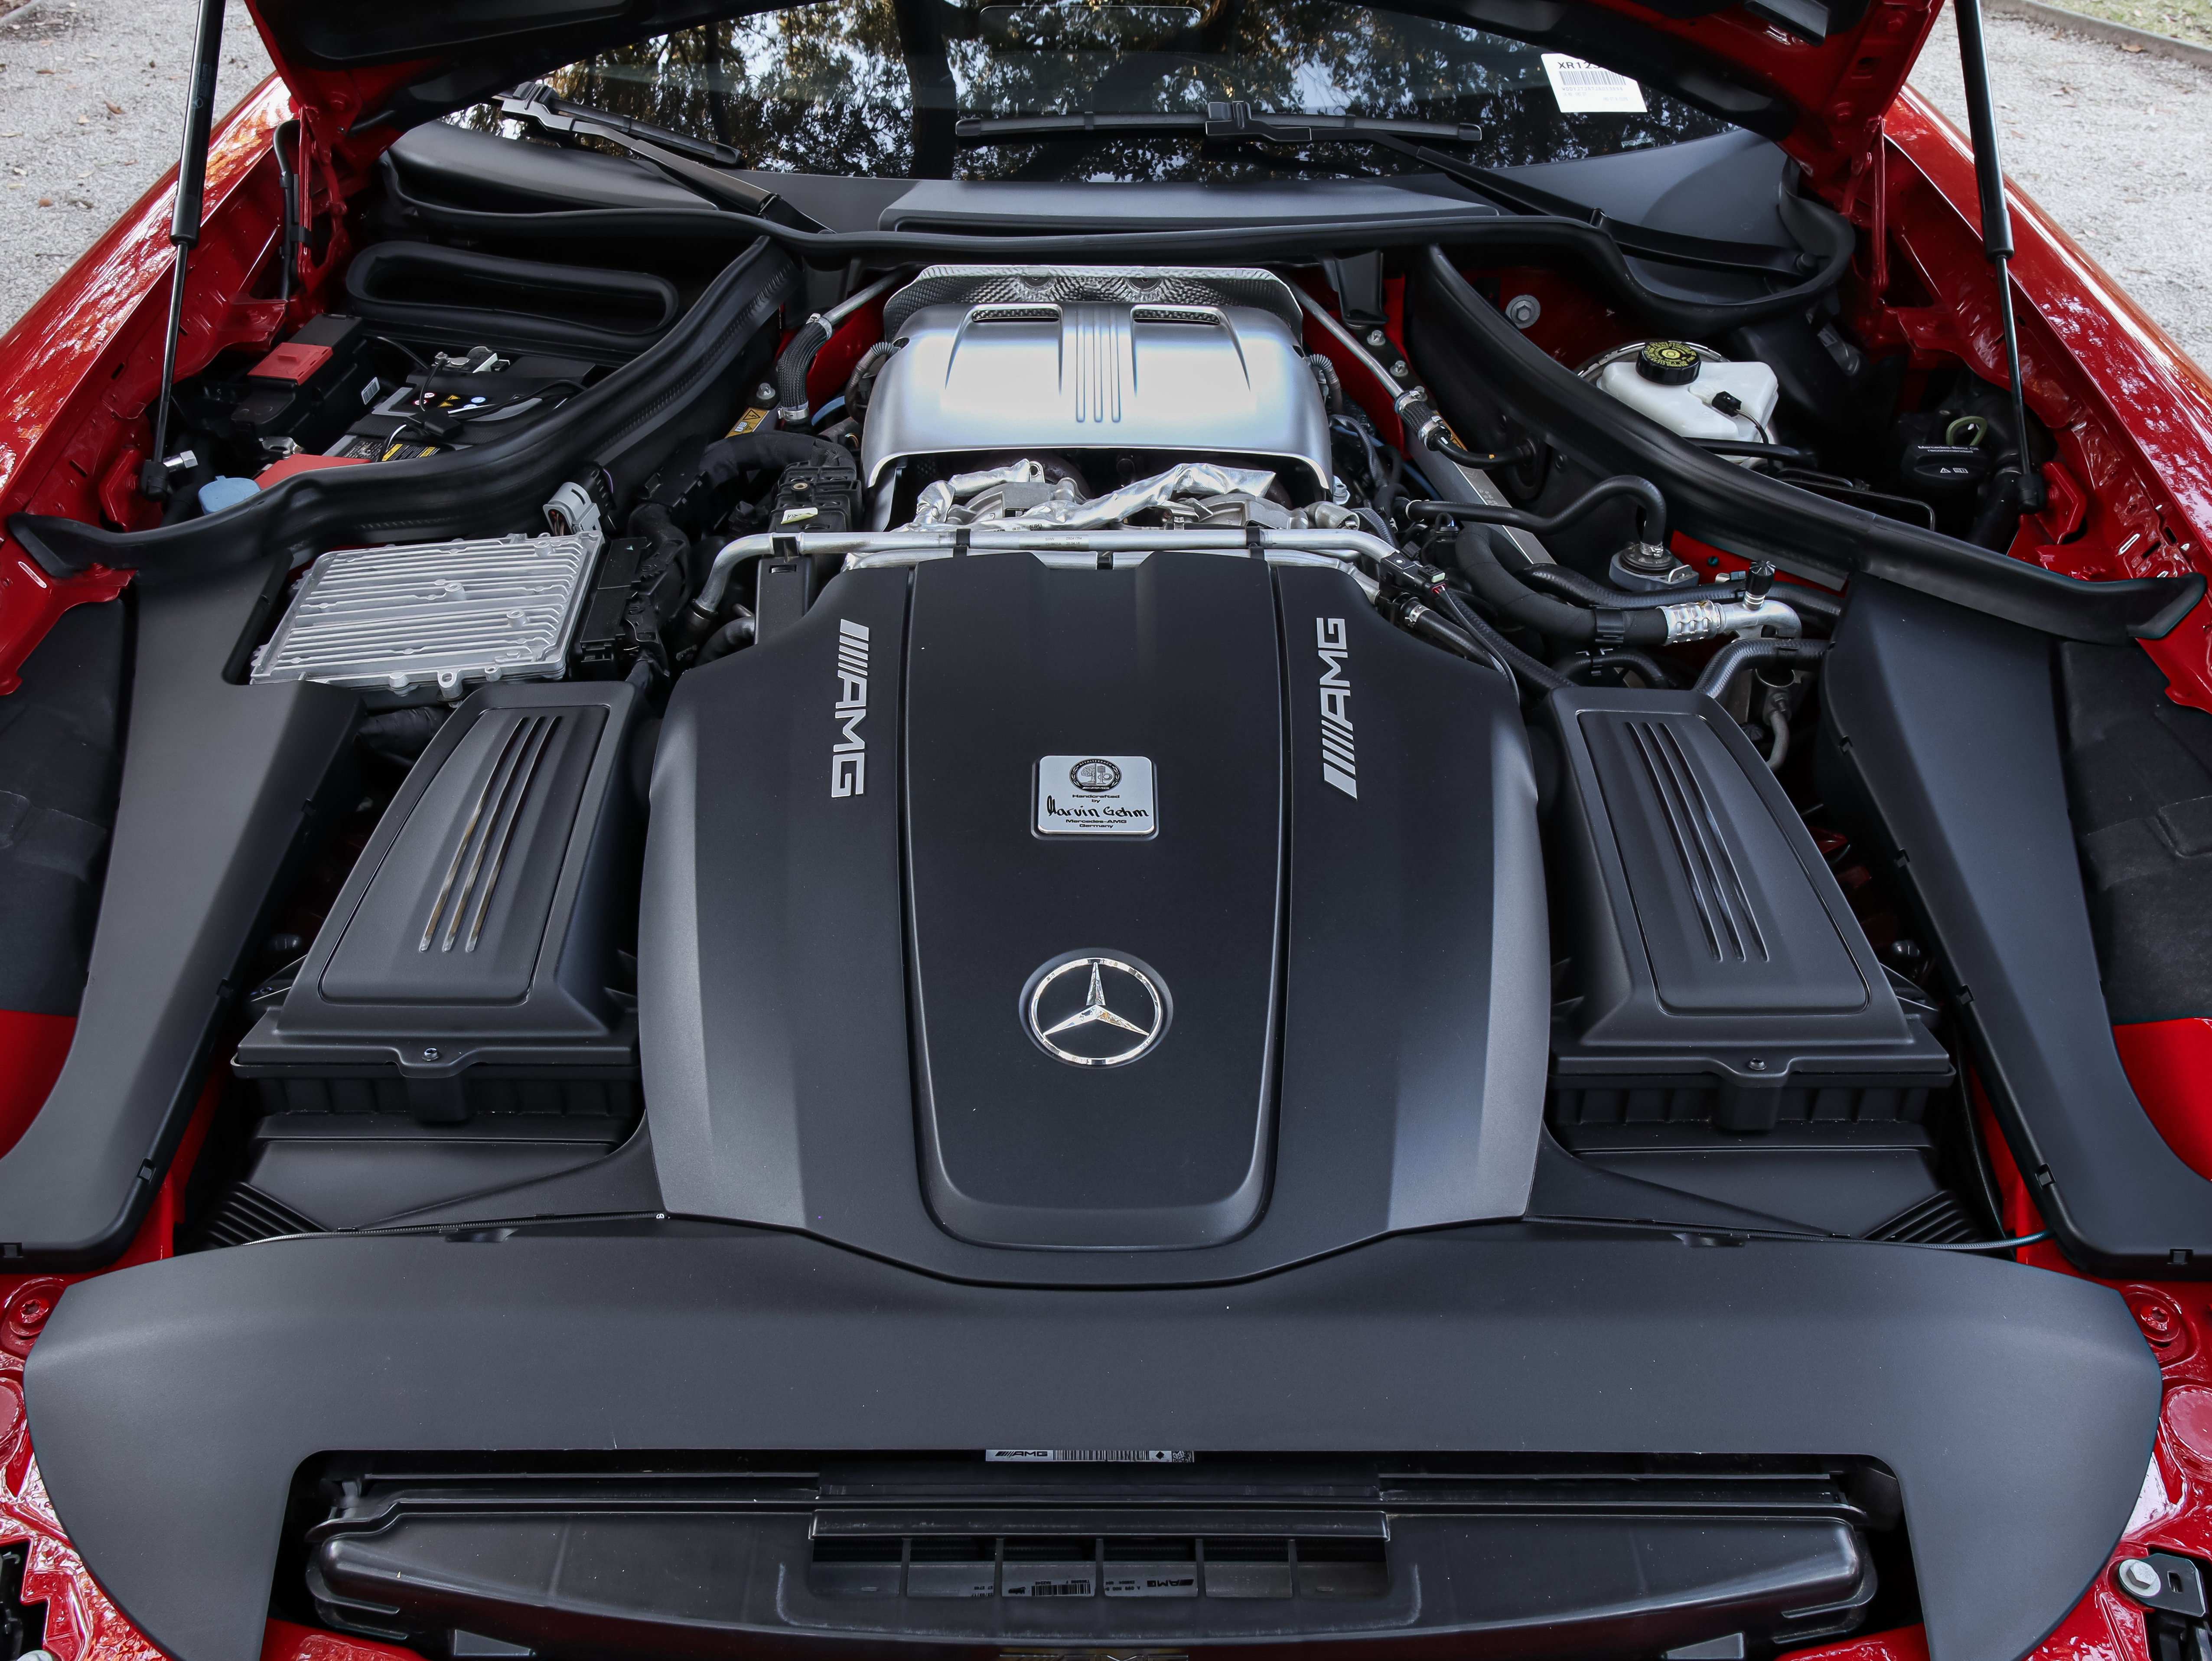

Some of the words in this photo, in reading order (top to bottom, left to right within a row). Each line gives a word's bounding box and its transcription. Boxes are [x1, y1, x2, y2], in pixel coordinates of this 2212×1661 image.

[1316, 617, 1353, 731] AMG
[831, 669, 867, 798] AMG
[1147, 1579, 1180, 1587] AMG
